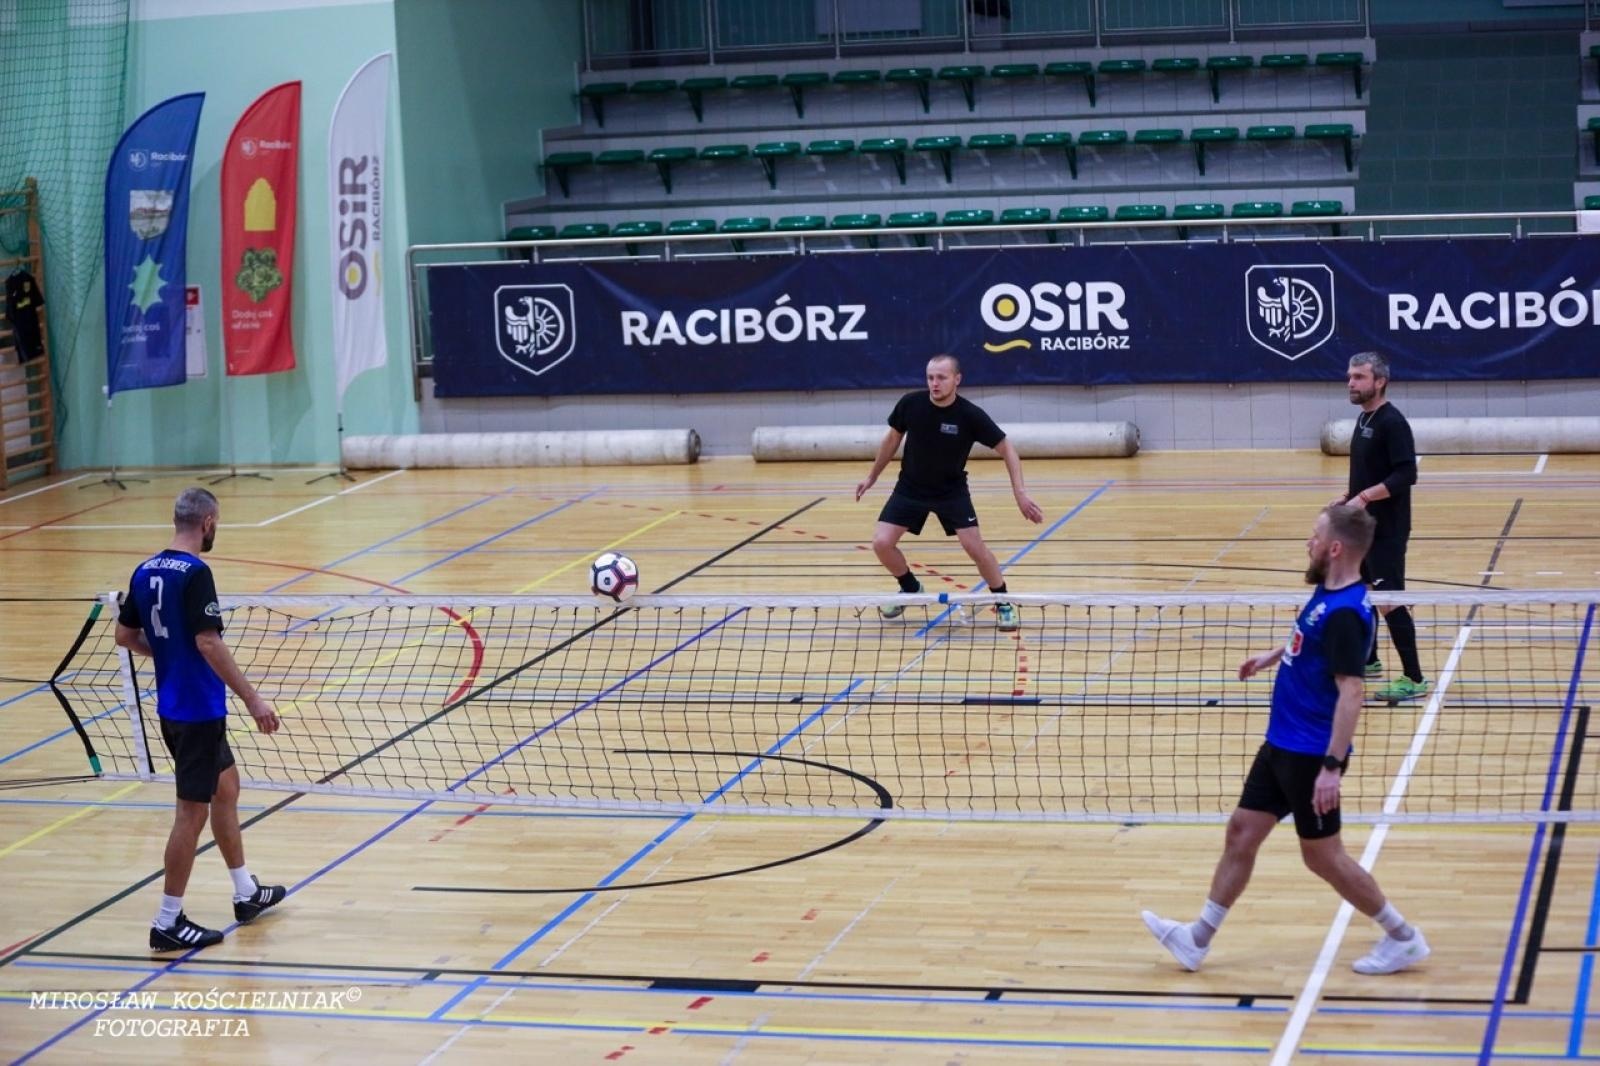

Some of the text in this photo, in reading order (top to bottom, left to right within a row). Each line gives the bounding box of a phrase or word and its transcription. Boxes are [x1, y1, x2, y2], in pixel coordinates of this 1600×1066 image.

[338, 155, 368, 300] OSiR
[621, 294, 868, 346] RACIBÓRZ
[981, 281, 1129, 332] OSiR
[1041, 331, 1130, 351] RACIBÓRZ
[149, 576, 169, 639] 2
